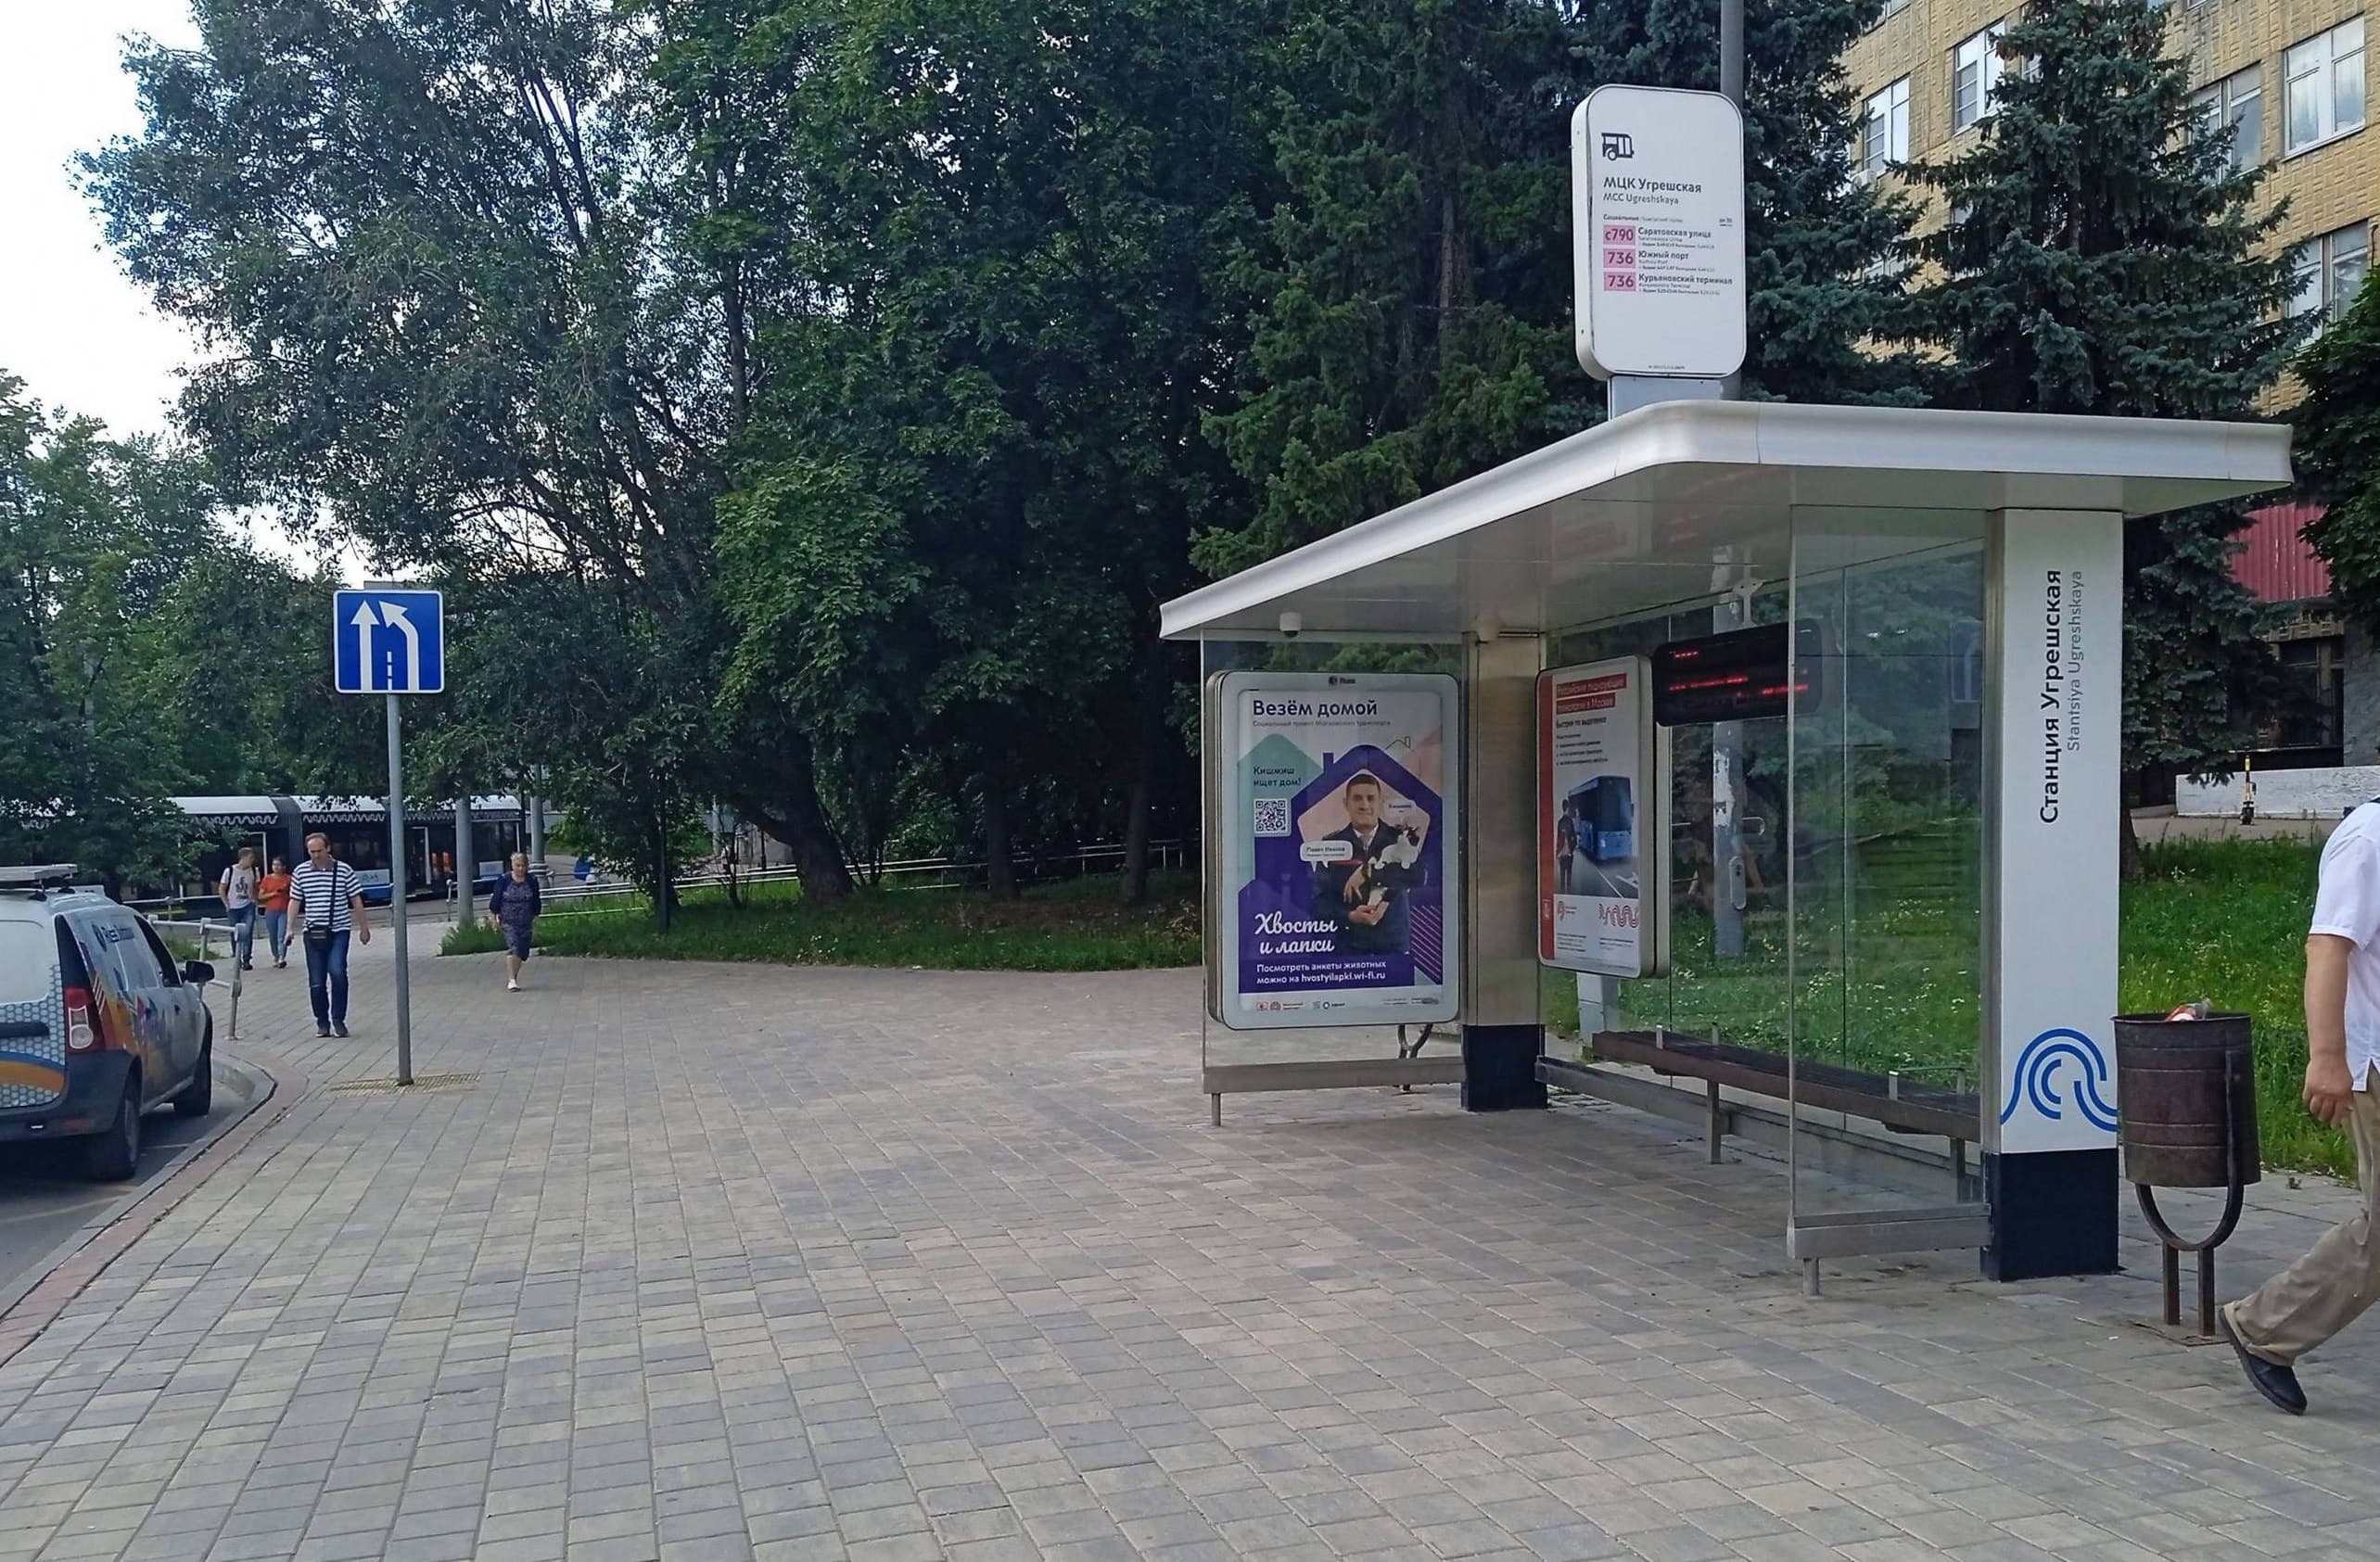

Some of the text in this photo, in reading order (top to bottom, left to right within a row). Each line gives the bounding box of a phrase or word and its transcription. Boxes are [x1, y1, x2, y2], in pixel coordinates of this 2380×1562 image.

[1603, 176, 1702, 193] МЦК Угрешская
[1603, 193, 1679, 206] MCC Ugreshskaya
[1605, 228, 1634, 241] с790
[1638, 227, 1687, 237] Саратовская
[1608, 251, 1634, 264] 736
[1638, 250, 1669, 259] Южный
[1608, 274, 1635, 287] 736
[1638, 273, 1695, 284] Курьяновский
[1696, 277, 1733, 286] терминал
[2068, 571, 2084, 751] Stantsiya Ugreshskaya
[2040, 570, 2064, 823] Станция Угрешская
[1253, 700, 1378, 718] Везём домой
[1253, 767, 1295, 775] Кишмиш
[1279, 778, 1302, 787] дом!
[1254, 910, 1338, 934] Хвосты
[1260, 939, 1335, 954] и лапки
[1256, 960, 1387, 973] Посмотреть анкеты животных
[1256, 976, 1287, 984] можно
